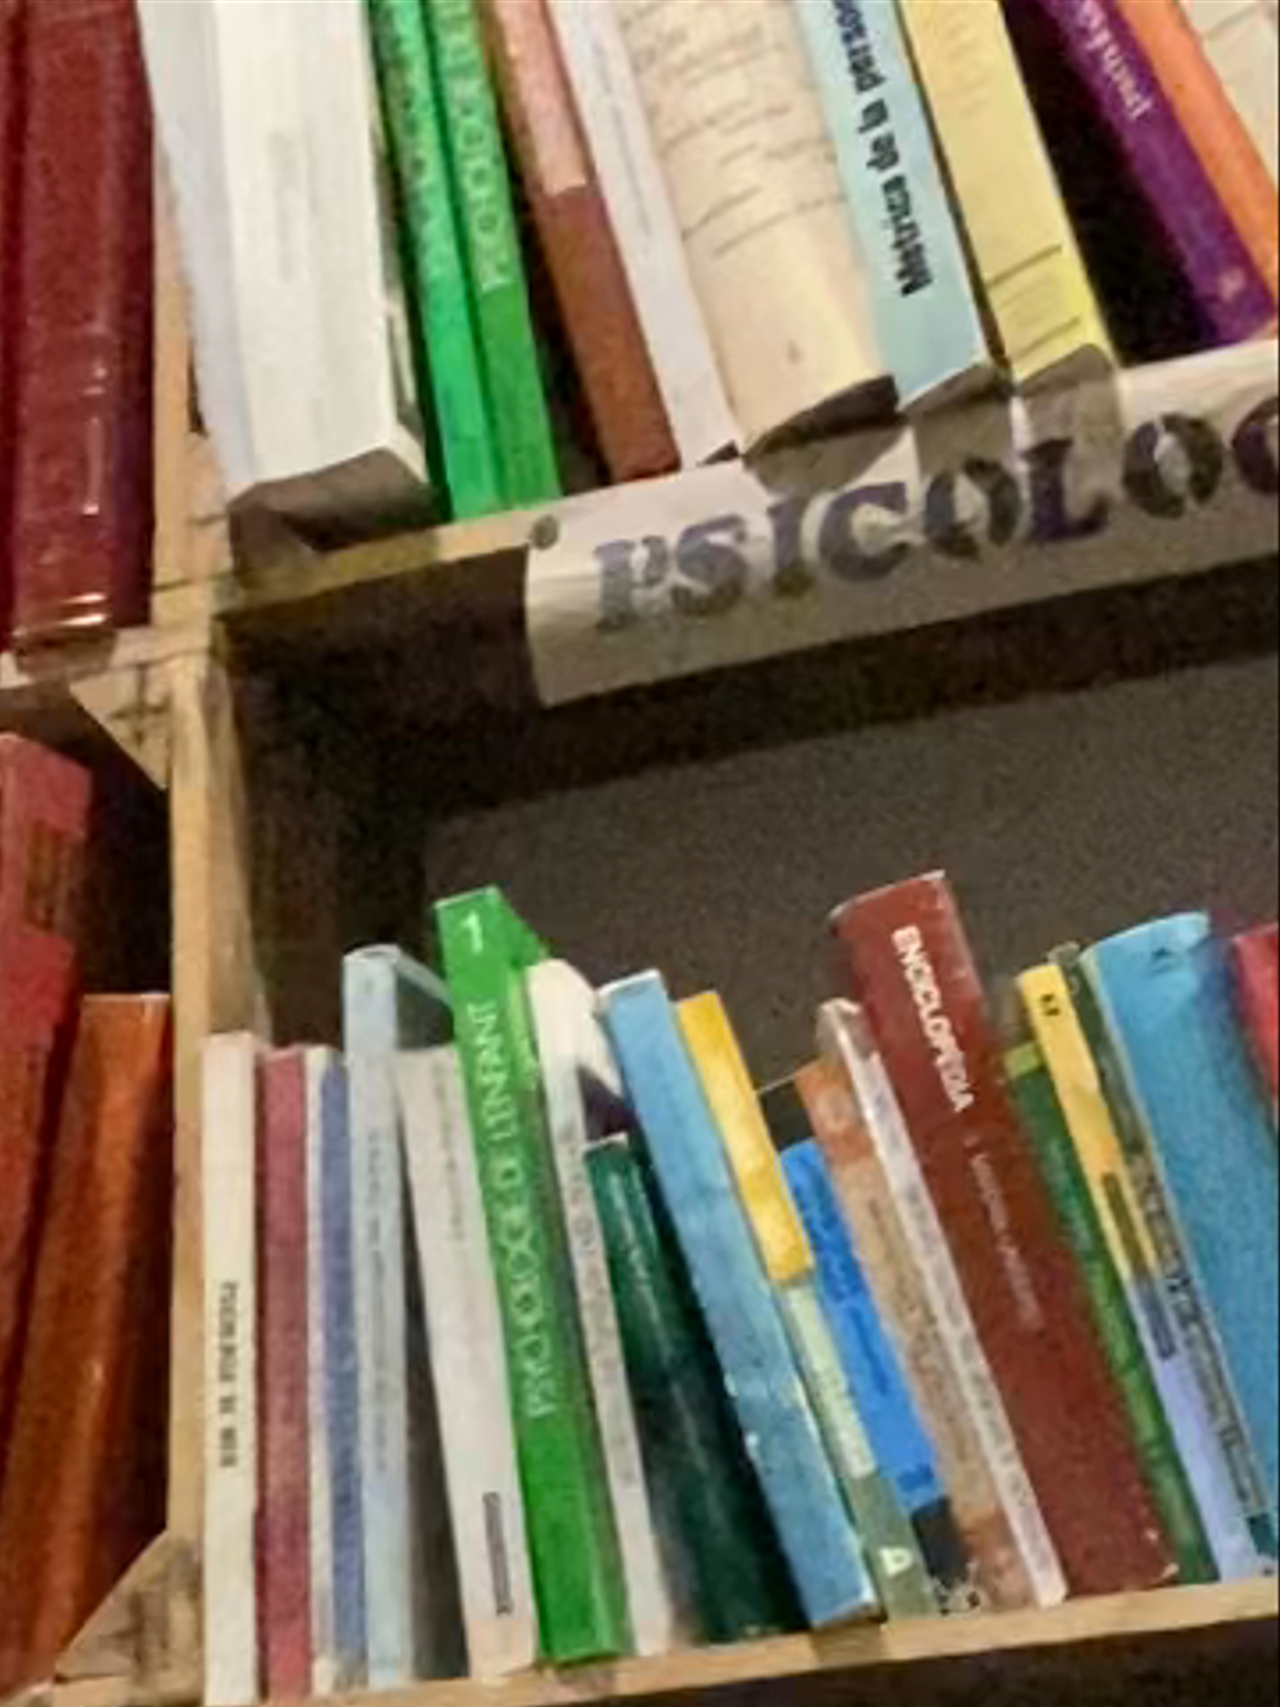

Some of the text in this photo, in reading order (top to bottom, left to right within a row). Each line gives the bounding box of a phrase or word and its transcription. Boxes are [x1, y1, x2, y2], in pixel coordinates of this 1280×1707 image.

[832, 0, 887, 94] perso
[459, 910, 484, 954] 1
[892, 926, 973, 1112] ENCICLOPÉDIA
